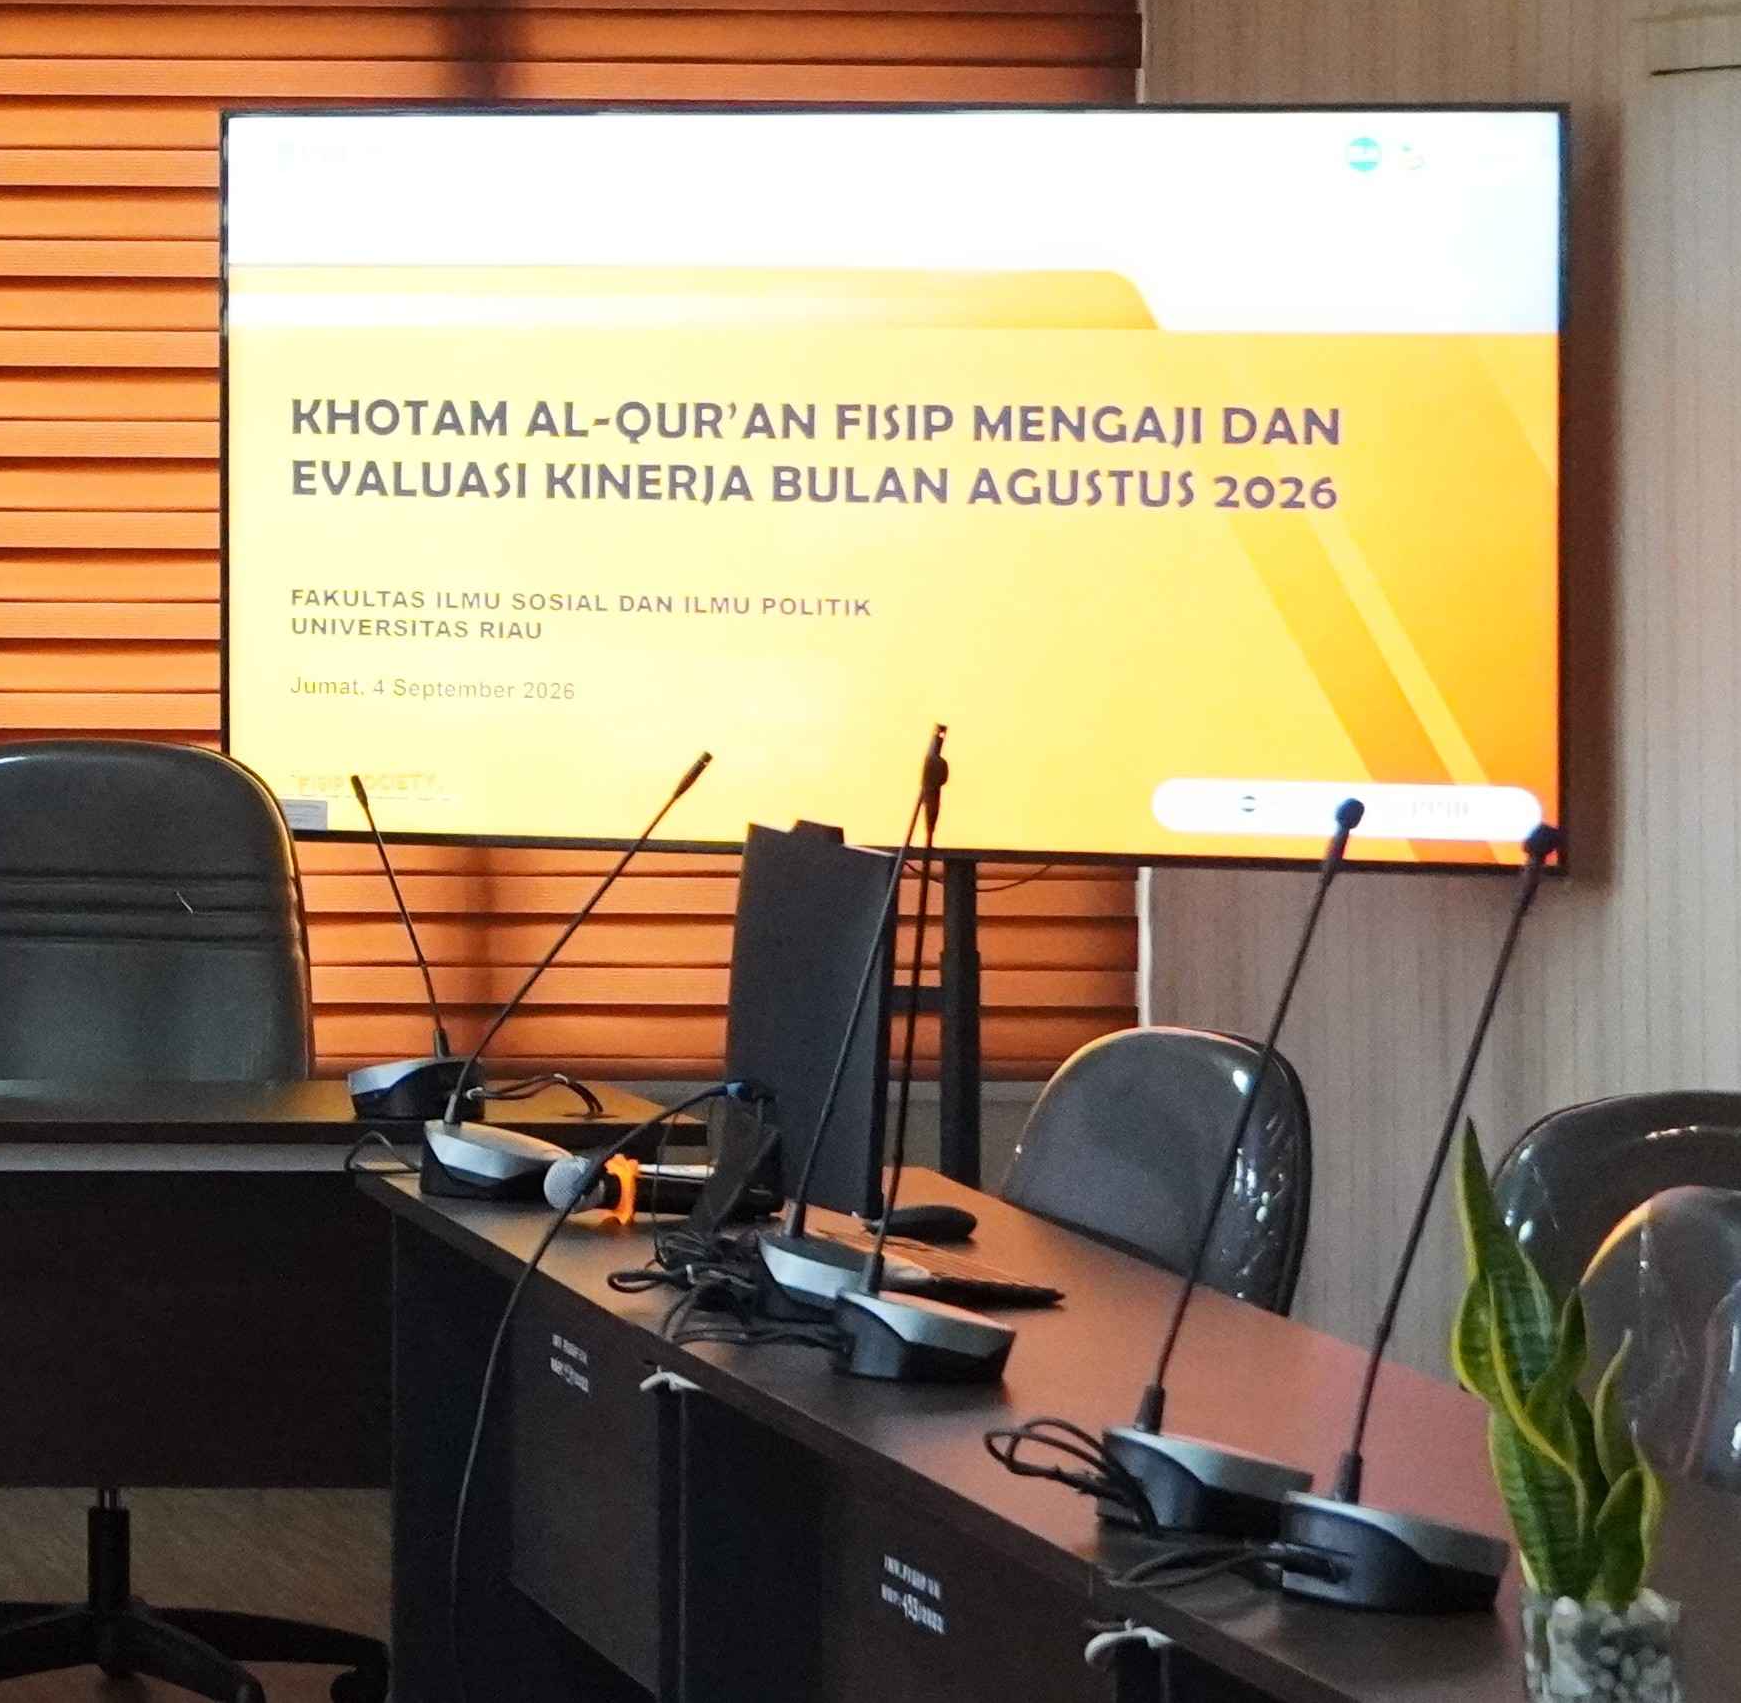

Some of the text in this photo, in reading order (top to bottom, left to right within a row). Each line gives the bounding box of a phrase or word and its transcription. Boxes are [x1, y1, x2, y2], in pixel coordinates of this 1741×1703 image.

[291, 398, 508, 436] KHOTAM
[835, 404, 954, 440] FISIP
[972, 406, 1202, 449] MENGAJI
[1222, 407, 1341, 446] DAN
[291, 459, 1338, 510] EVALUASI KINERJA BULAN AGUSTUS 2026
[291, 589, 871, 617] FAKULTAS ILMU SOSIAL DAN ILMU POLITIK
[291, 617, 542, 640] UNIVERSITAS RIAU
[373, 678, 385, 696] 4
[393, 678, 516, 700] September
[523, 681, 575, 700] 2026
